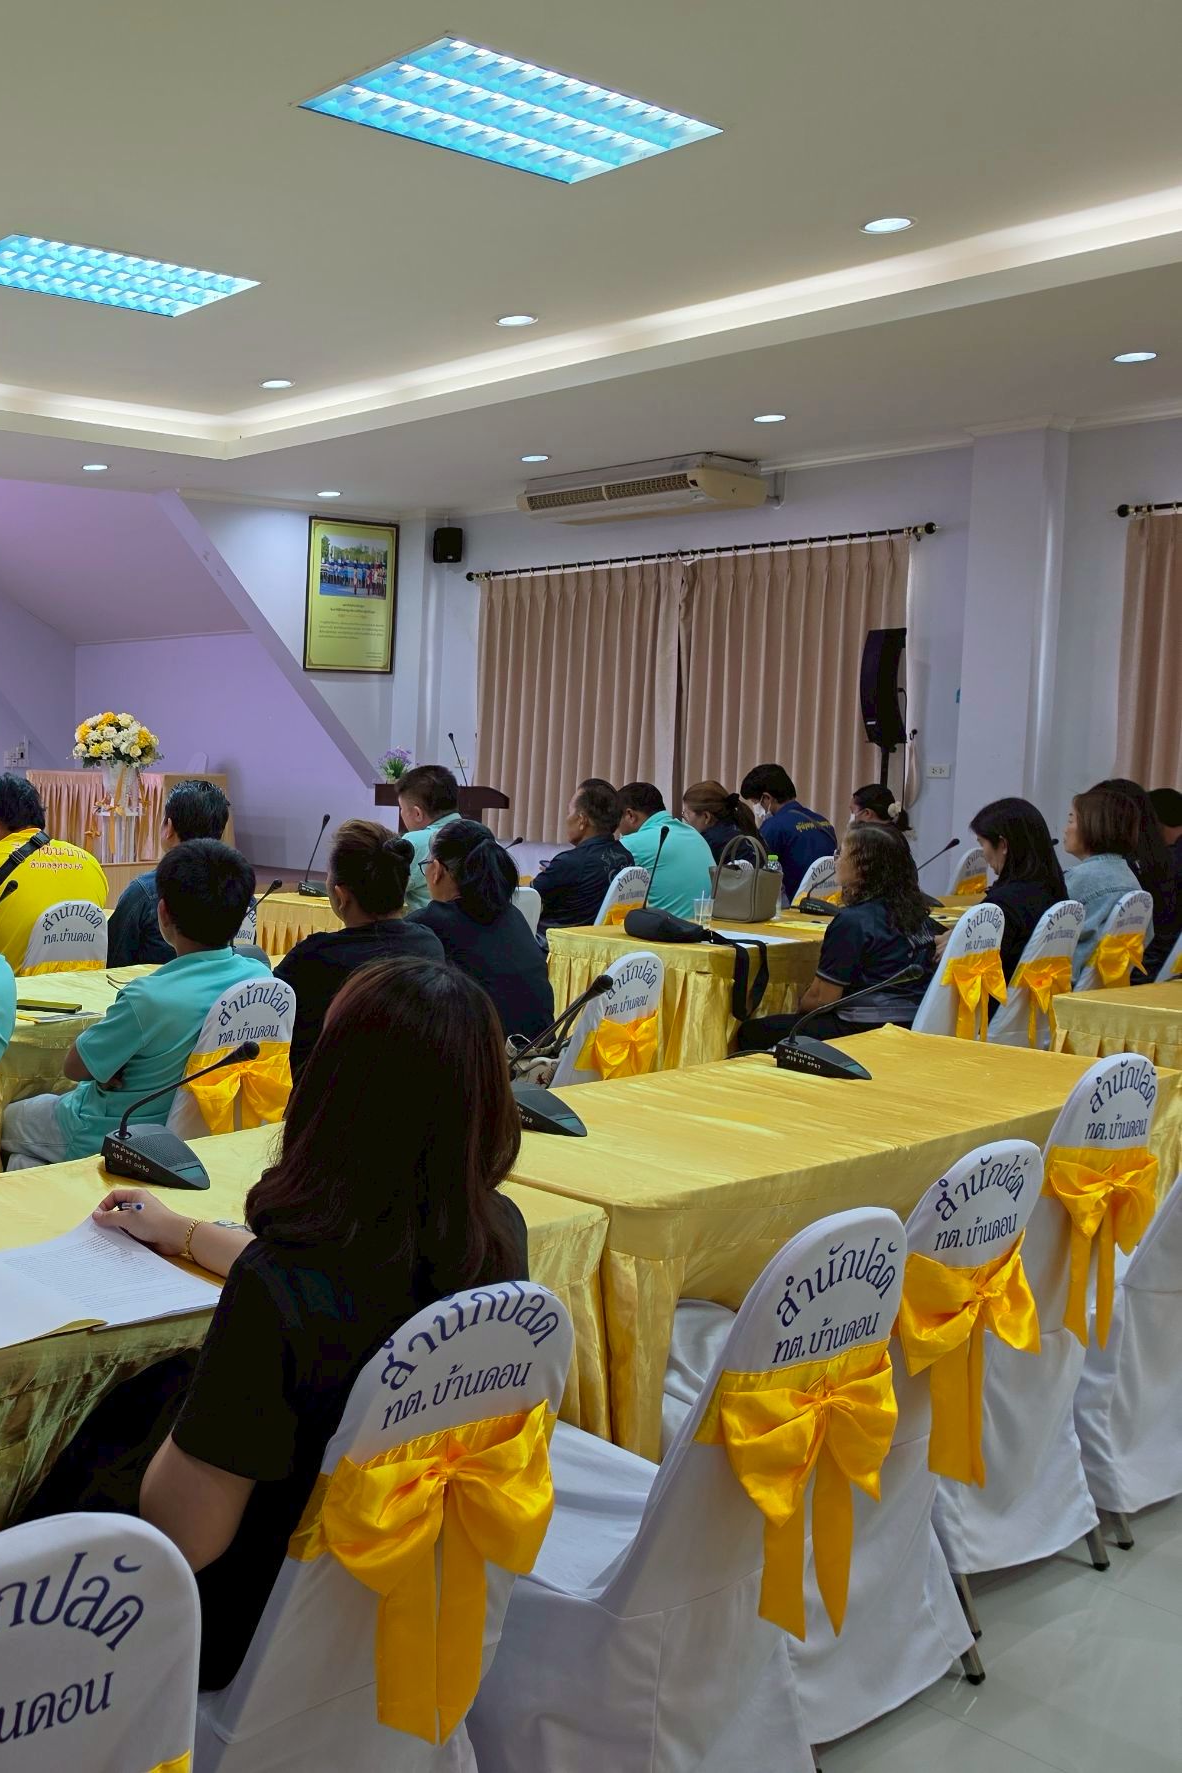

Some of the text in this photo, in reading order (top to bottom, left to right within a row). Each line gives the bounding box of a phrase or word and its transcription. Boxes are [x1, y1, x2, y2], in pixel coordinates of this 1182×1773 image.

[42, 903, 103, 931] สำนักปลัด
[43, 928, 95, 945] ทต.บ้านดอน
[218, 982, 291, 1027] สำนักปลัด
[217, 1021, 280, 1046] ทต.บ้านดอน
[1089, 1060, 1157, 1114] สำนักปลัด
[1084, 1113, 1148, 1140] ทต.บ้านดอน
[935, 1154, 1031, 1222] สำนักปลัด
[933, 1212, 1018, 1251] ทต.บ้านดอน
[776, 1237, 898, 1327] สำนักปลัด
[772, 1312, 880, 1364] ทต.บ้านดอน
[381, 1361, 533, 1431] ทต.บ้านดอน
